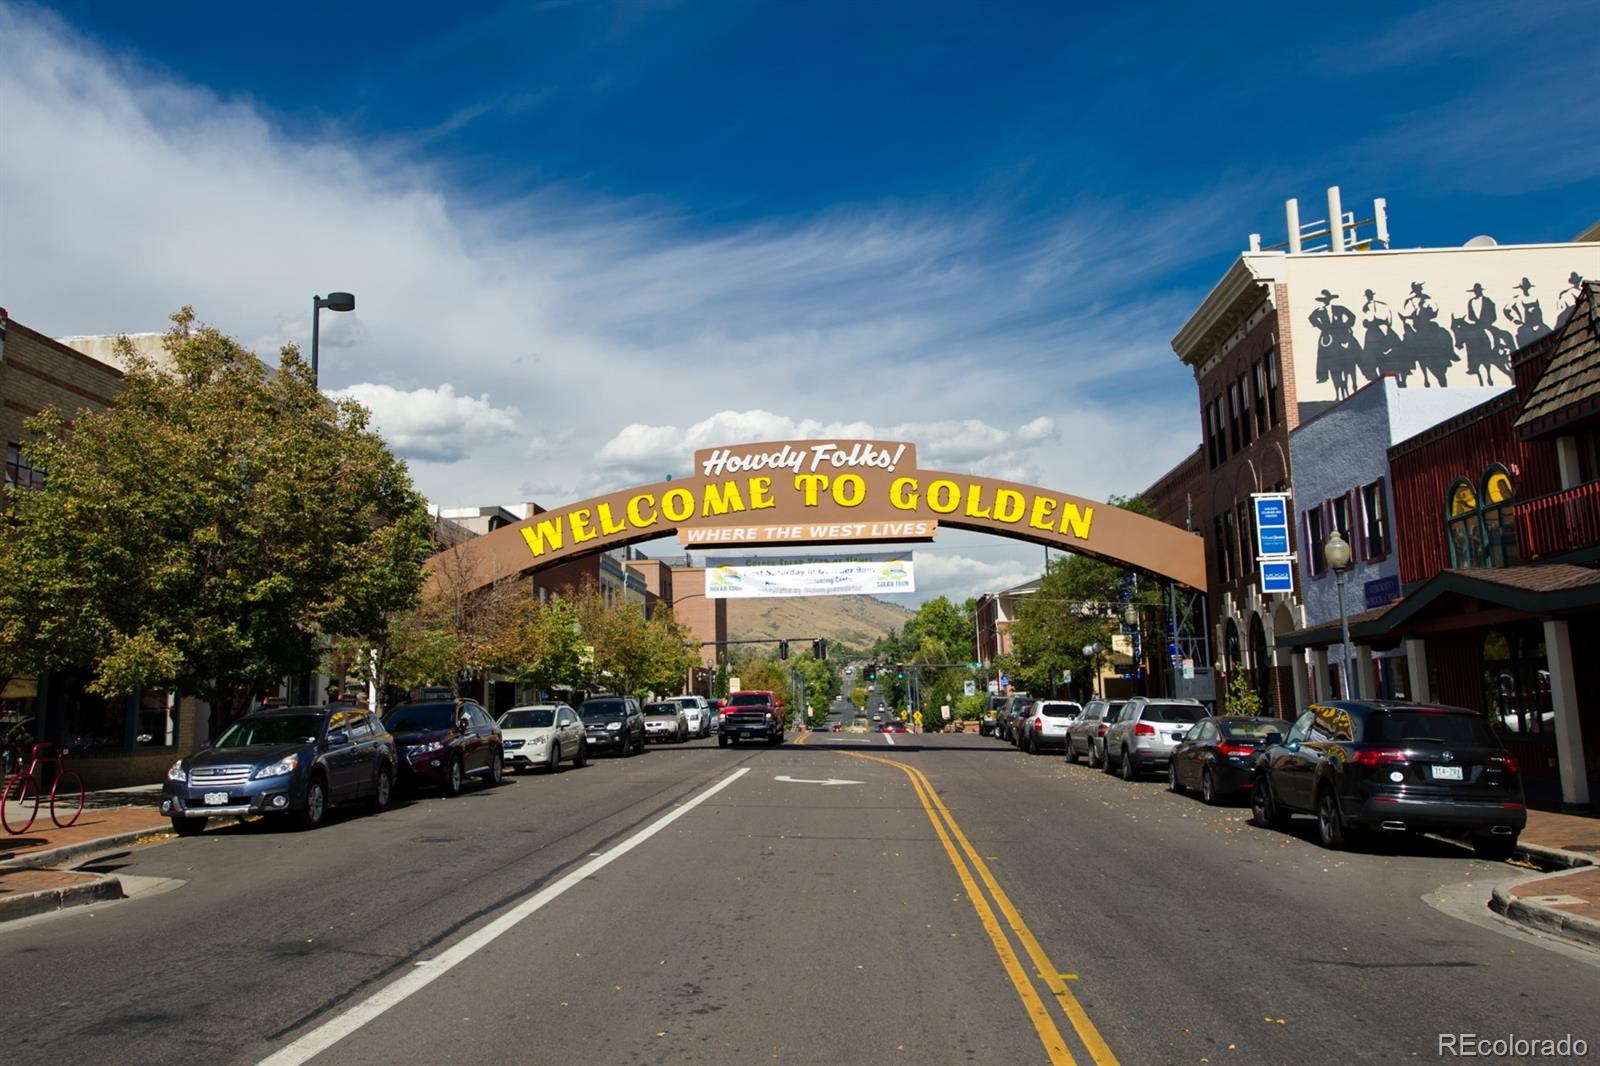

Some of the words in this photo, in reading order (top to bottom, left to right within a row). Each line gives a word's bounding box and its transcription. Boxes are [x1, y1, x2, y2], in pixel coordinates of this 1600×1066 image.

[703, 445, 807, 476] Howdy
[810, 443, 906, 473] Folks!
[519, 476, 776, 557] WELCOME
[794, 473, 867, 507] TO
[889, 476, 1095, 540] GOLDEN
[687, 527, 757, 542] WHERE
[765, 526, 803, 540] THE
[809, 524, 866, 538] WEST
[871, 522, 928, 536] LIVES
